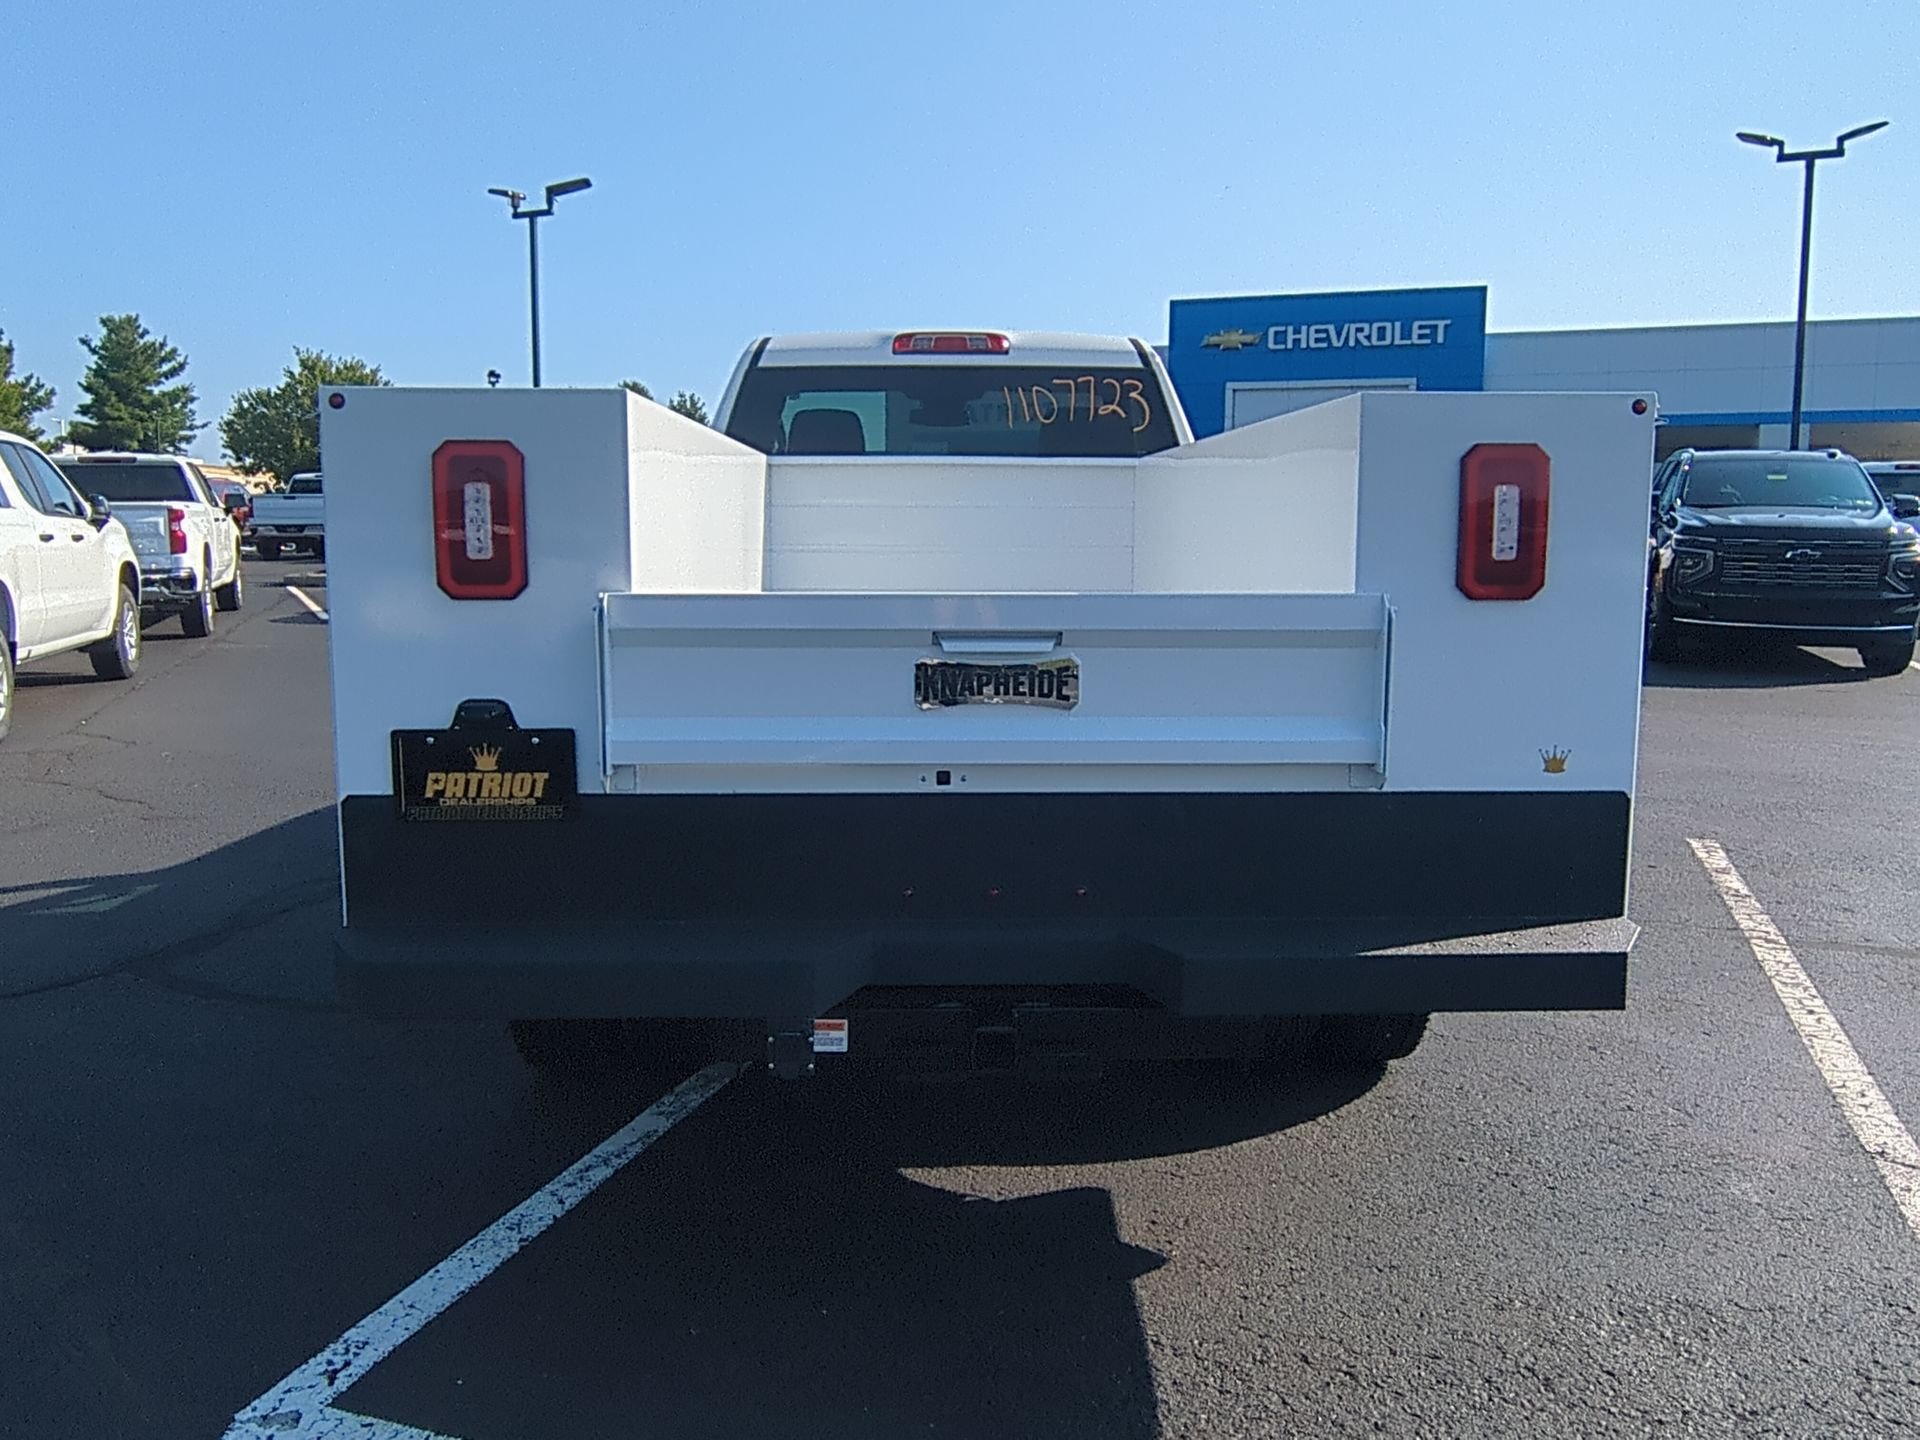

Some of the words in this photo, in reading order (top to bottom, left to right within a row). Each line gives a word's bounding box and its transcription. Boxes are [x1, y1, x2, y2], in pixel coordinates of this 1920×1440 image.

[1267, 319, 1452, 350] CHEVROLET
[1003, 375, 1150, 433] 1107723
[921, 665, 1072, 703] KNAPHEIDE
[424, 772, 550, 798] PATRIOT
[439, 797, 537, 807] DEALERSHIPS
